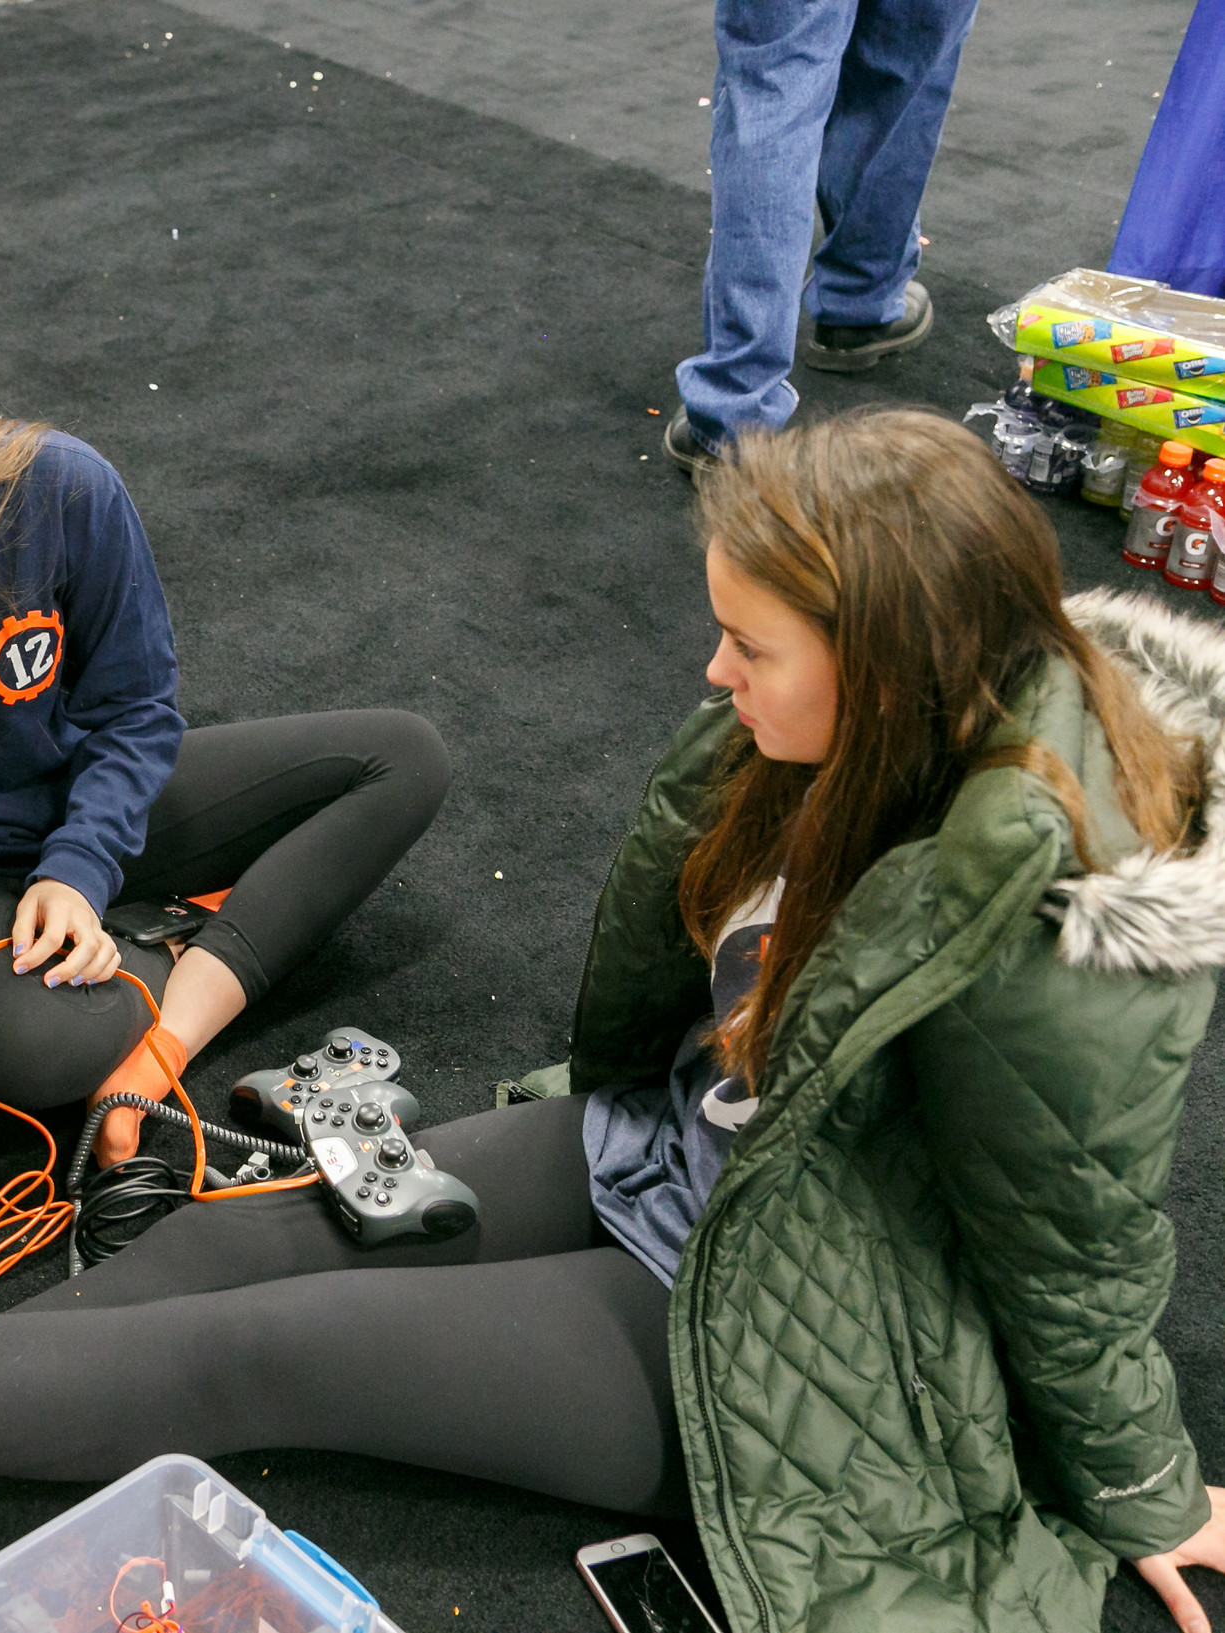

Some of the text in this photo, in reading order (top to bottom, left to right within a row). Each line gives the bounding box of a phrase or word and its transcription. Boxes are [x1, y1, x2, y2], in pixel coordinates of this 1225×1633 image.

[1185, 533, 1209, 556] G
[5, 631, 54, 690] 12
[326, 1146, 344, 1174] VEX
